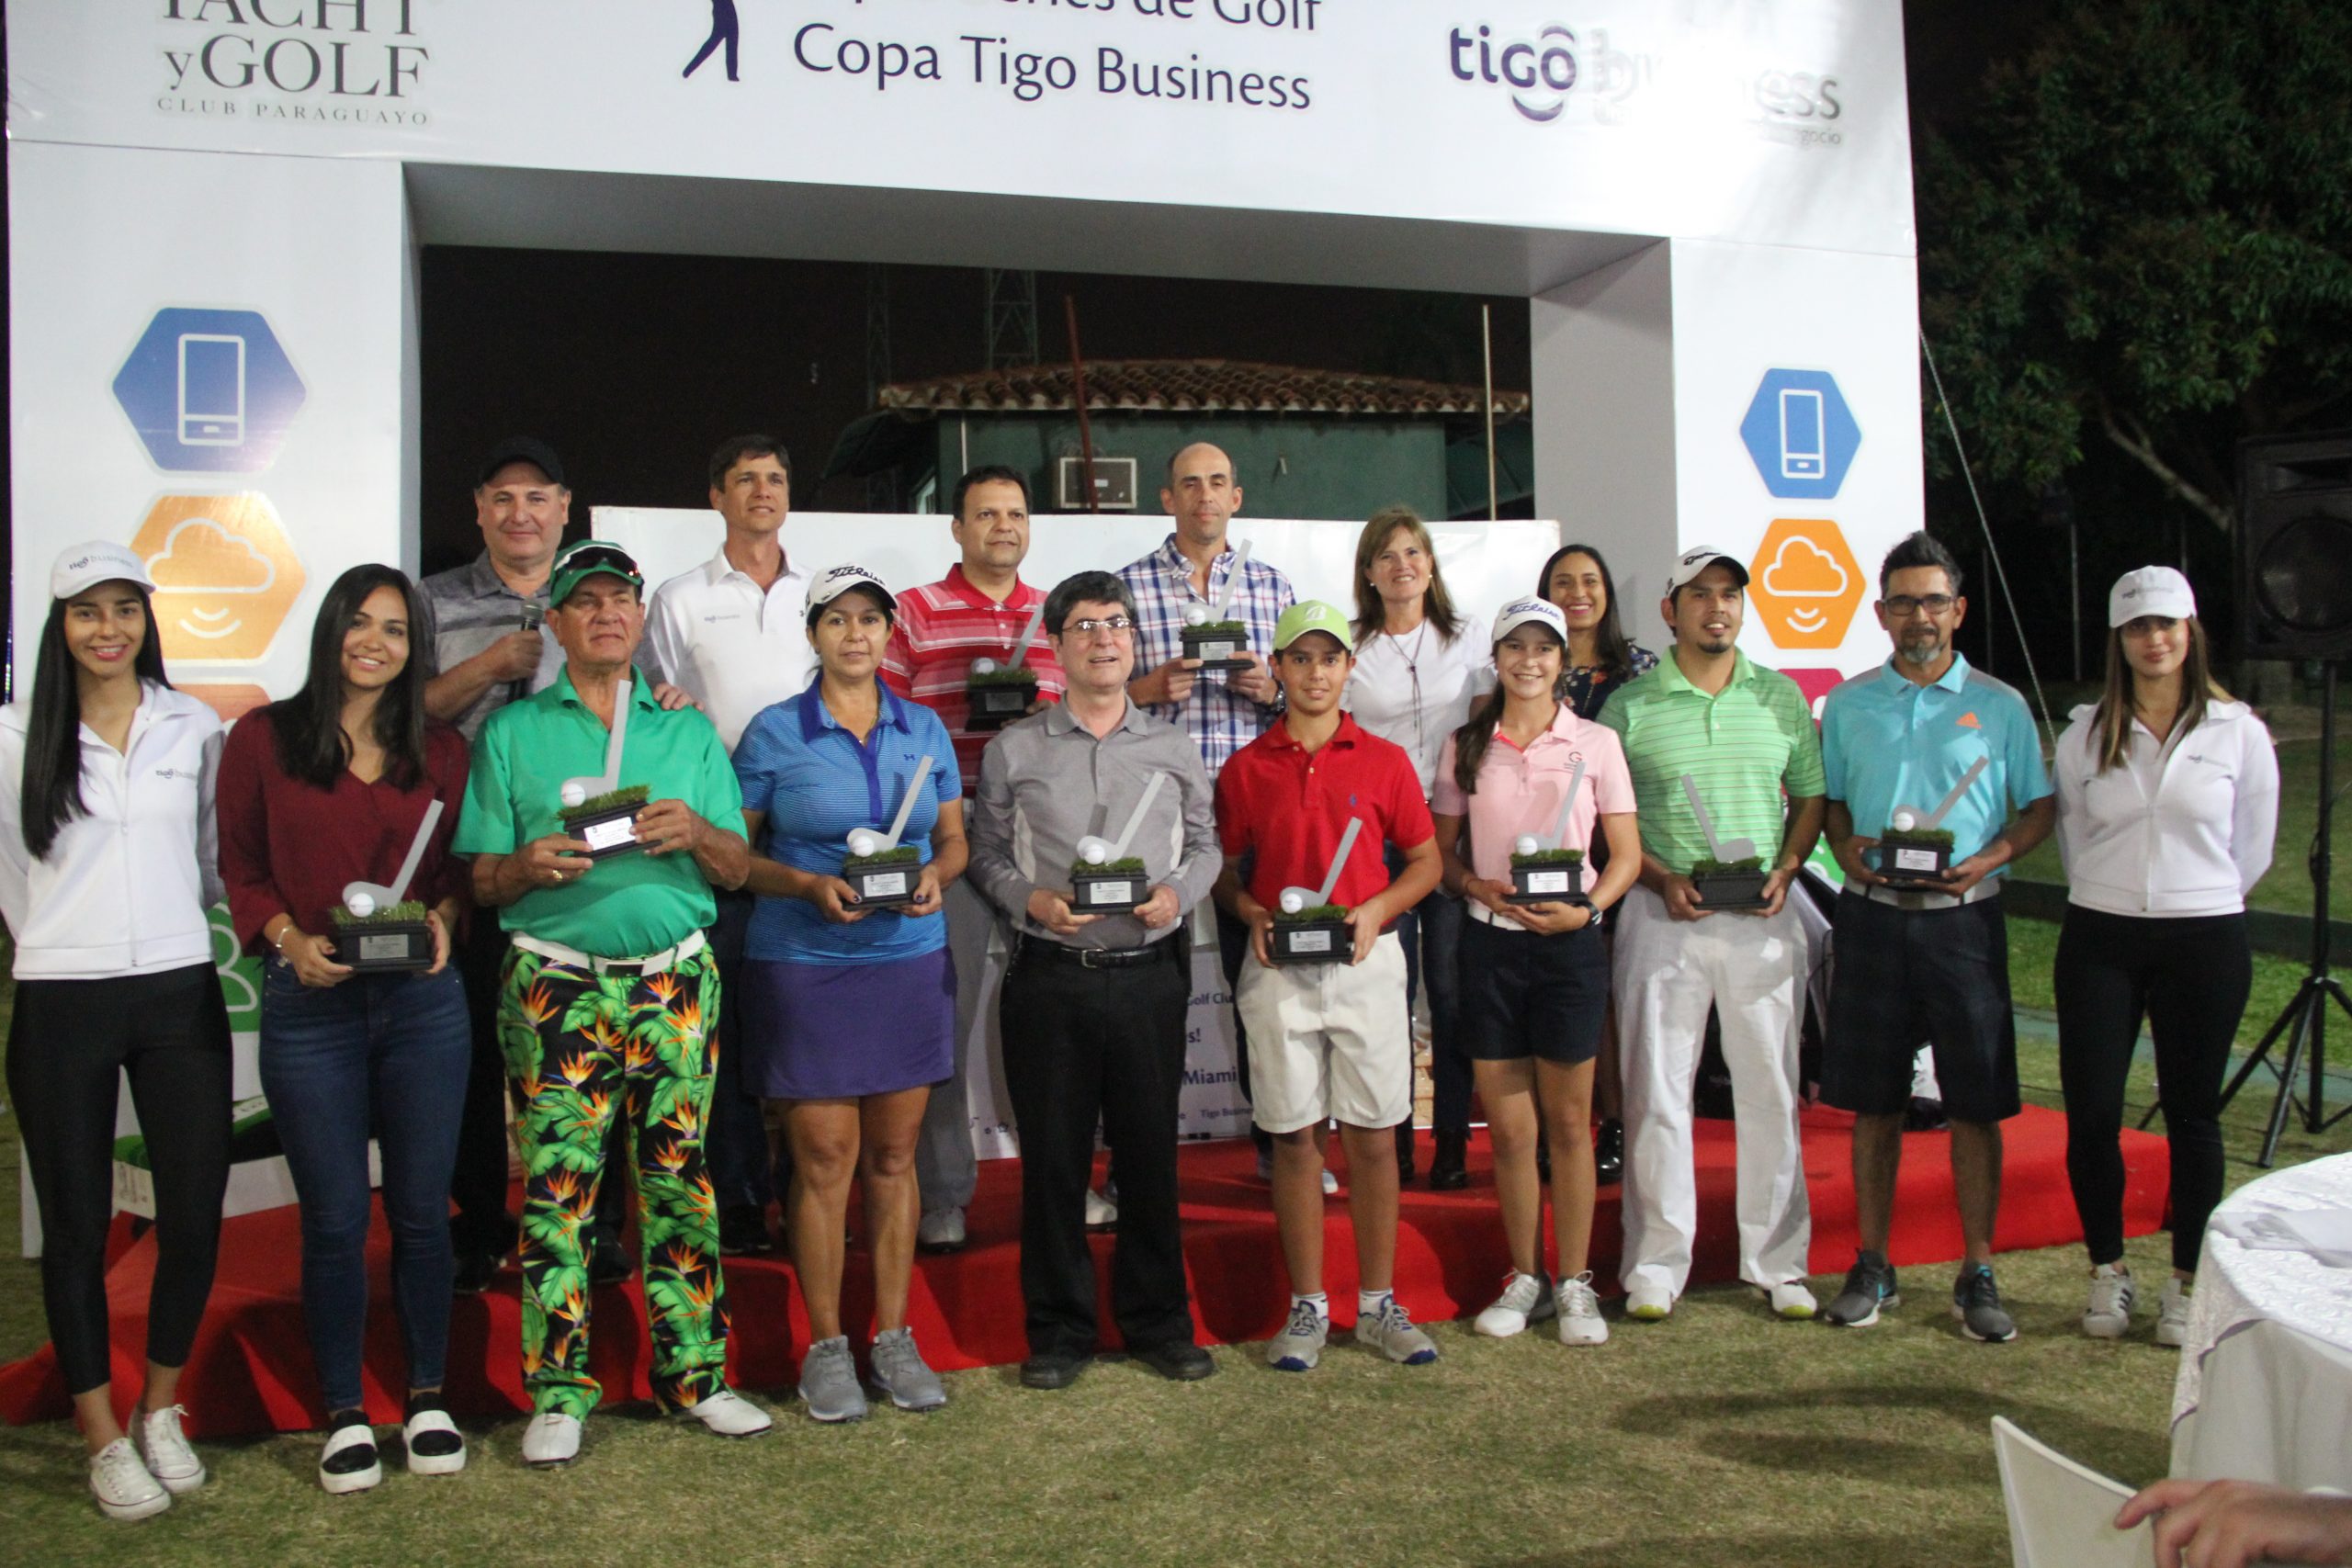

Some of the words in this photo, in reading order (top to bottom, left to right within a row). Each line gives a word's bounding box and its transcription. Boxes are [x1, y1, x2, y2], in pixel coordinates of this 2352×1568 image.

[1214, 0, 1321, 30] Golf
[794, 23, 942, 90] Copa
[960, 35, 1077, 102] Tigo
[1098, 47, 1311, 109] Business
[1450, 26, 1577, 120] tigo
[157, 97, 235, 115] CLUB
[257, 103, 427, 126] PARAGUAYO
[1181, 1066, 1238, 1086] Miami
